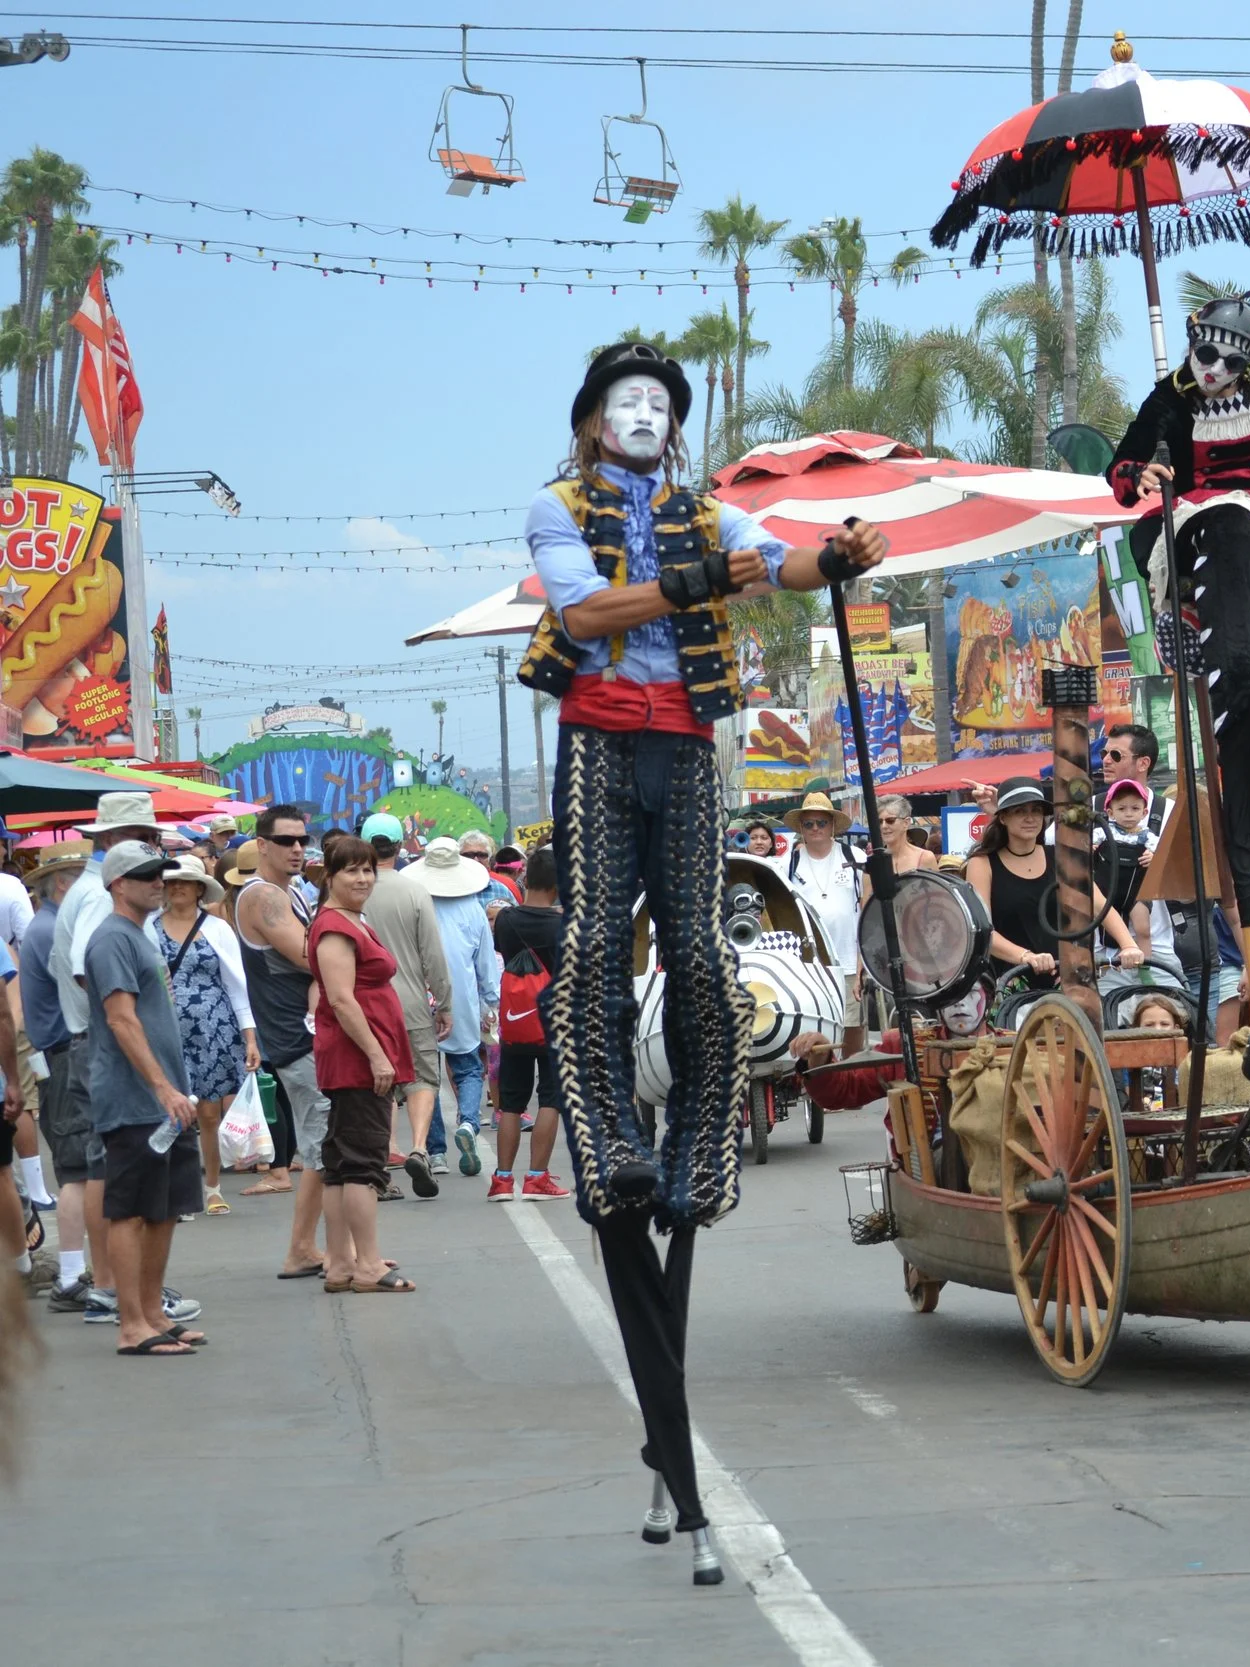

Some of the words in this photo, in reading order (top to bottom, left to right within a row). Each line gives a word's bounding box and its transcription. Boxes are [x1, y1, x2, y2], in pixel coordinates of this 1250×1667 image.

[0, 488, 62, 528] OT
[0, 522, 86, 575] GS!
[1034, 618, 1058, 637] Chips
[855, 658, 889, 670] ROAST
[891, 658, 908, 669] BEE
[1104, 667, 1133, 679] GRAN
[74, 688, 121, 712] FOOTLONG
[80, 684, 109, 701] SUPER
[83, 705, 124, 727] REGULAR
[94, 703, 107, 713] OR
[1021, 733, 1035, 748] THE
[972, 825, 985, 834] ST
